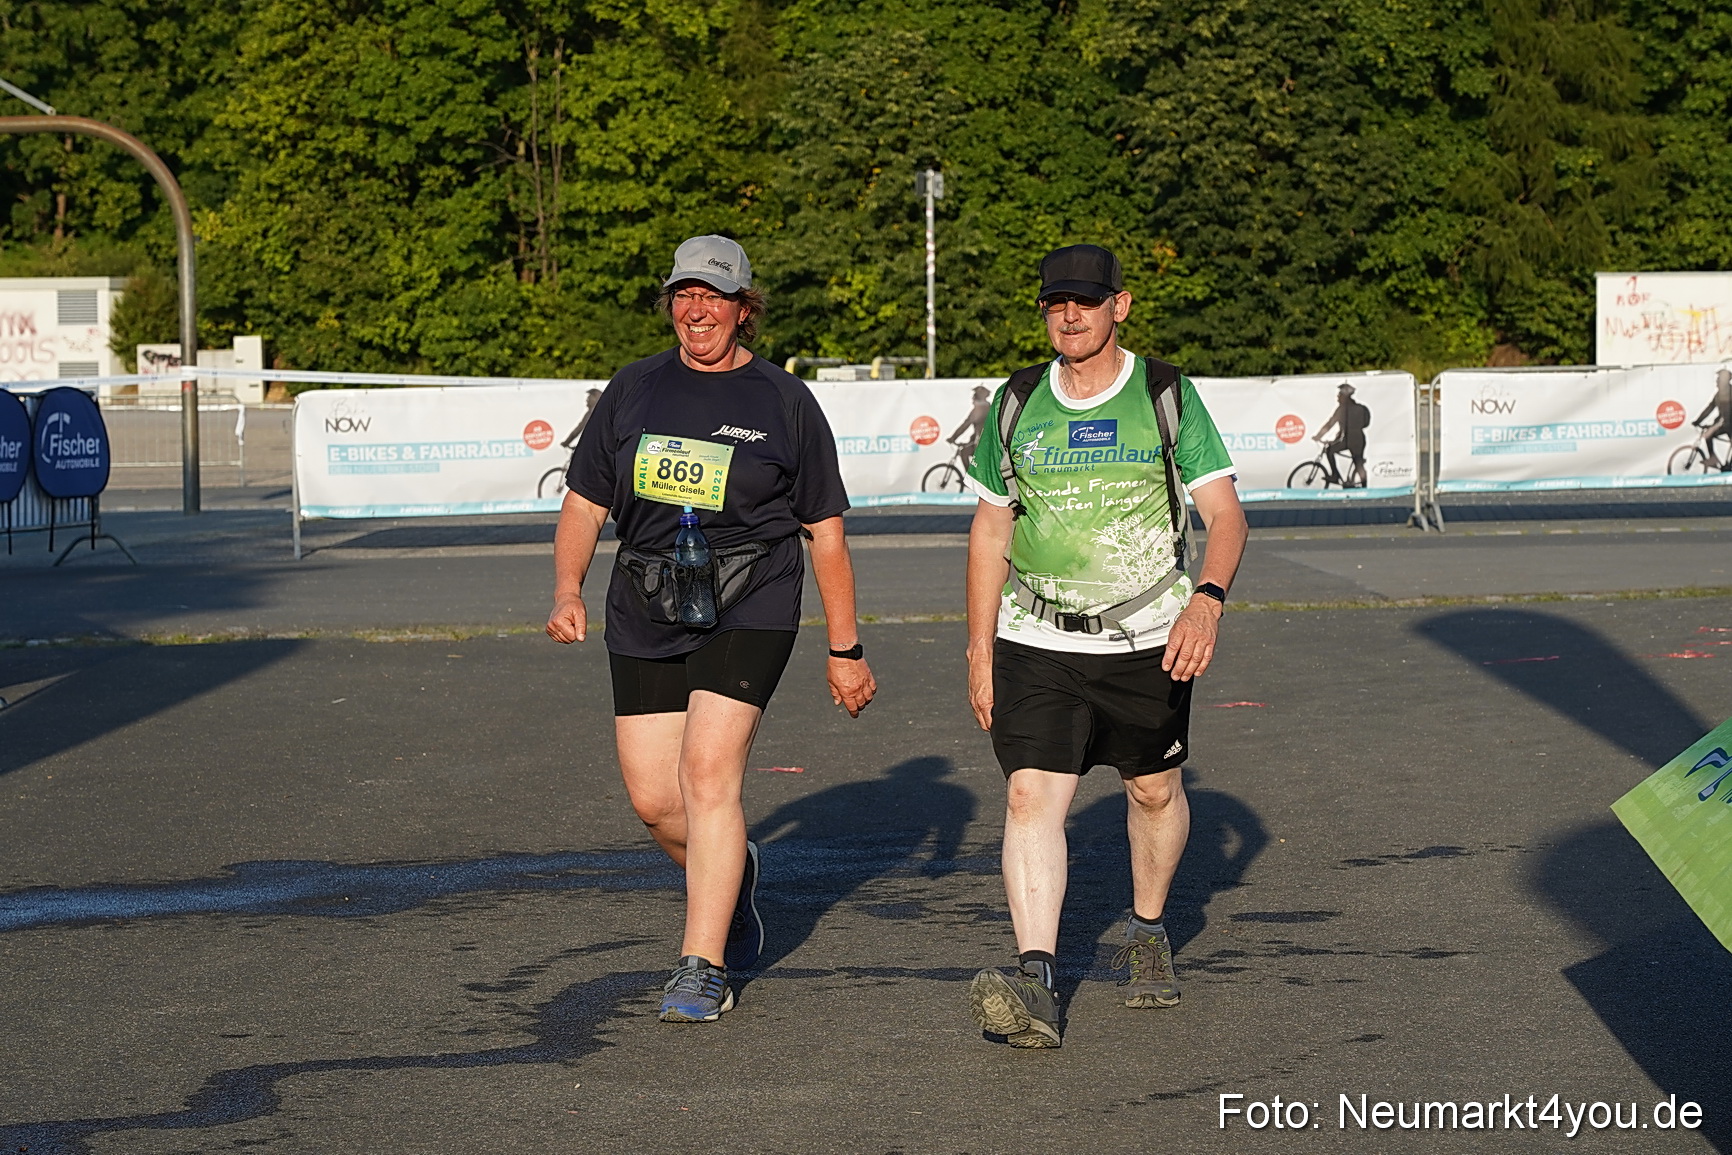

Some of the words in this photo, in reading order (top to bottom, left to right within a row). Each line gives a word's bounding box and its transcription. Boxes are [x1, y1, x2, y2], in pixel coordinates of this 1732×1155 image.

[1471, 399, 1516, 414] NOW
[325, 416, 371, 433] NOW
[1473, 427, 1537, 443] E-BIKES
[1540, 426, 1553, 440] &
[1557, 419, 1659, 438] FAHRRÄDER
[1013, 430, 1026, 444] 10
[1080, 430, 1115, 440] Fischer
[50, 432, 100, 456] Fischer
[329, 446, 398, 461] E-BIKES
[402, 445, 416, 460] &
[420, 440, 526, 460] FAHRRÄDER
[1043, 443, 1162, 465] firmenlauf
[55, 458, 100, 469] AUTOMOBILE
[657, 457, 704, 485] 869
[1043, 464, 1095, 473] neumarkt
[638, 457, 649, 490] WALK
[651, 480, 678, 492] Müller
[679, 484, 706, 496] Gisela
[711, 469, 723, 500] 2022
[1089, 478, 1147, 492] Firmen
